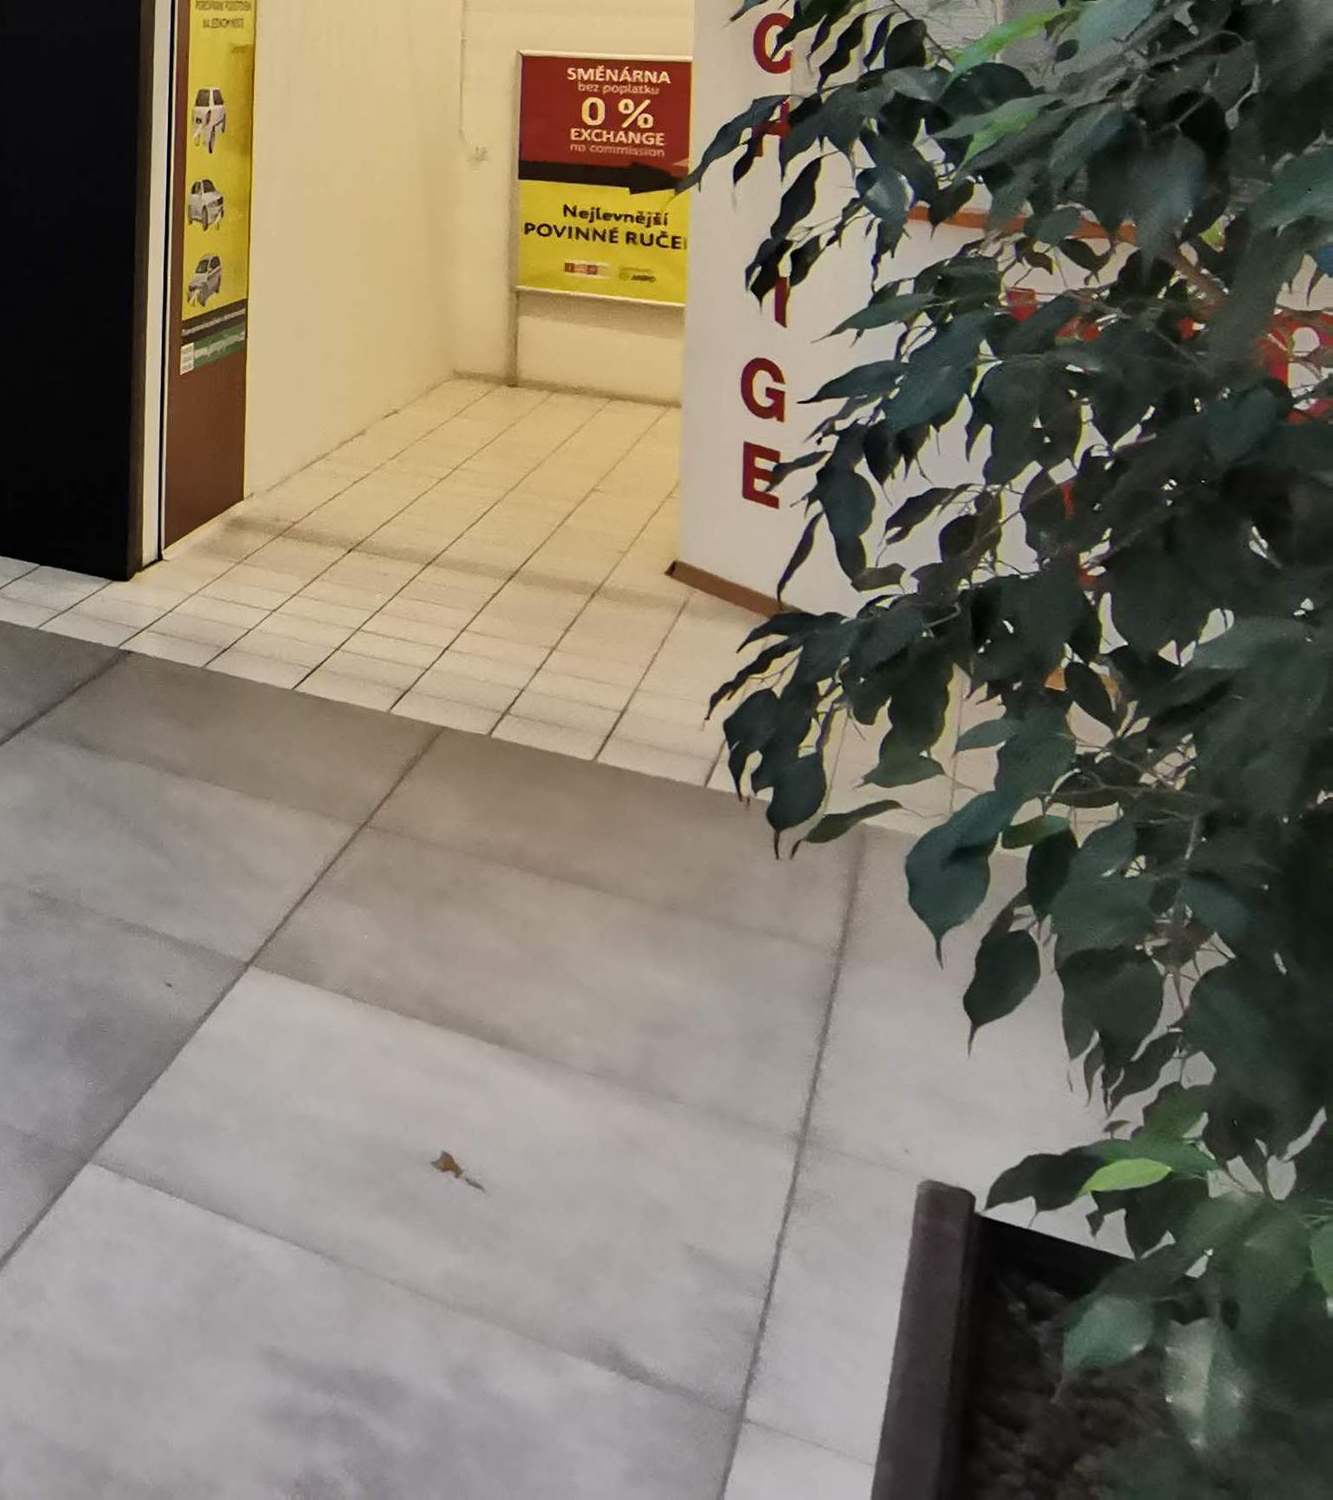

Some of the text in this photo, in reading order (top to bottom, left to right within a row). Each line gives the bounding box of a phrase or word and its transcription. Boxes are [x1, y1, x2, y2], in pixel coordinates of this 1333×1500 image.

[566, 65, 671, 84] SMĚNÁRNA
[577, 81, 660, 96] bez poplatku
[581, 96, 654, 129] 0 %
[570, 127, 666, 146] EXCHANGE
[570, 143, 666, 158] no commission
[563, 204, 669, 228] Nejlevnější
[523, 222, 687, 250] POVINNÉ RUČE
